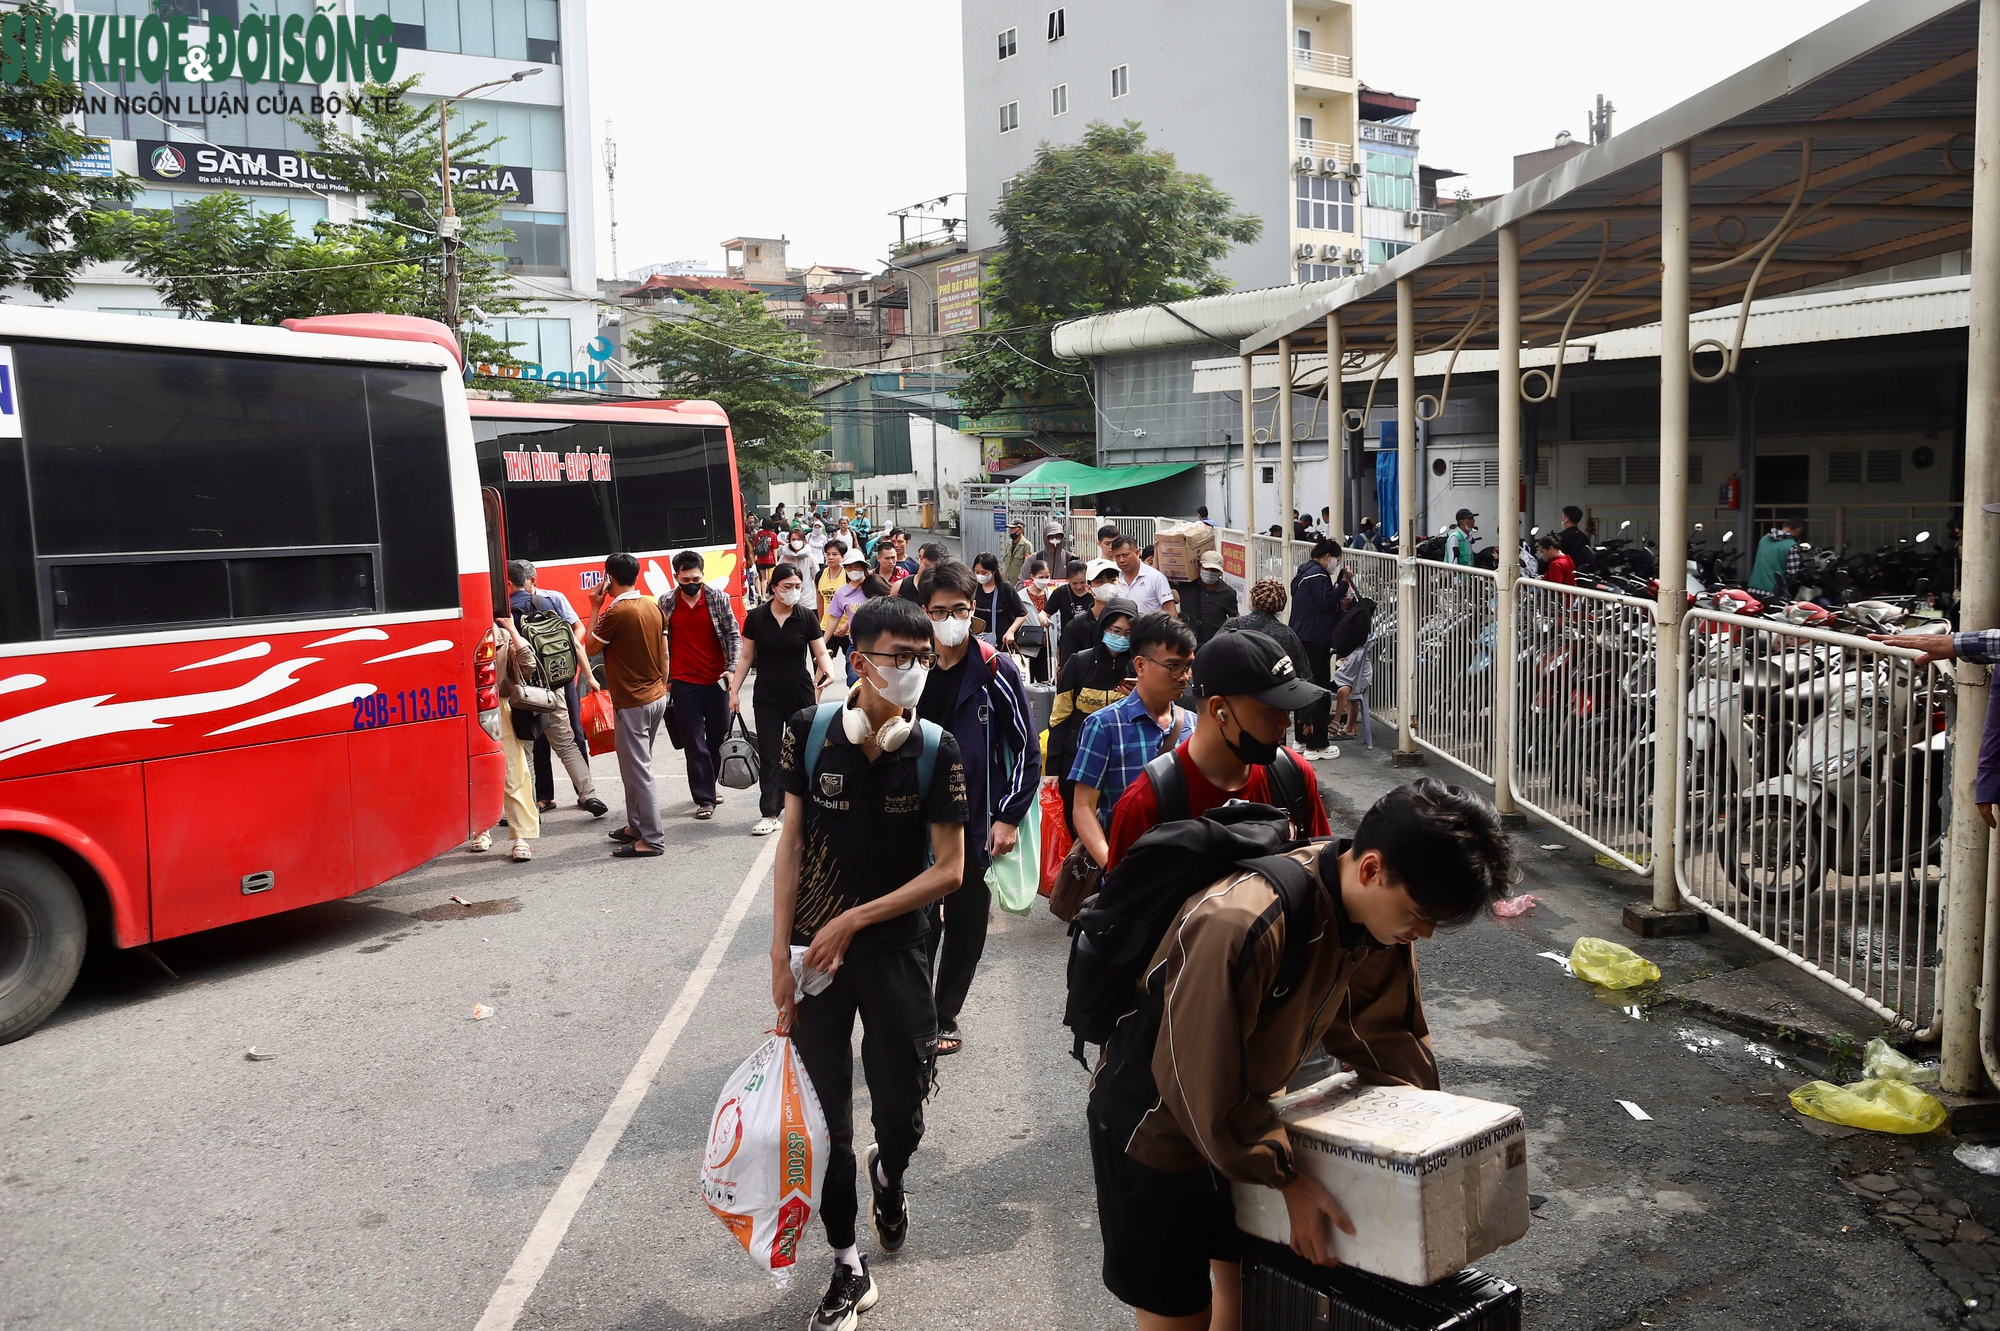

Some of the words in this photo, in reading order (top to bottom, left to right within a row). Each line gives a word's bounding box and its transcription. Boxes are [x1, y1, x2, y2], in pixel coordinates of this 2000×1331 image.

[196, 150, 268, 176] SAM
[260, 179, 288, 187] Southern
[951, 279, 963, 293] BÁT
[503, 444, 533, 481] THÁI
[590, 446, 612, 481] BÁT
[353, 684, 459, 729] 29B-113.65
[1493, 1124, 1515, 1143] NAM
[788, 1131, 806, 1187] 3002SP
[1321, 1142, 1348, 1158] NAM
[1351, 1150, 1375, 1166] KIM
